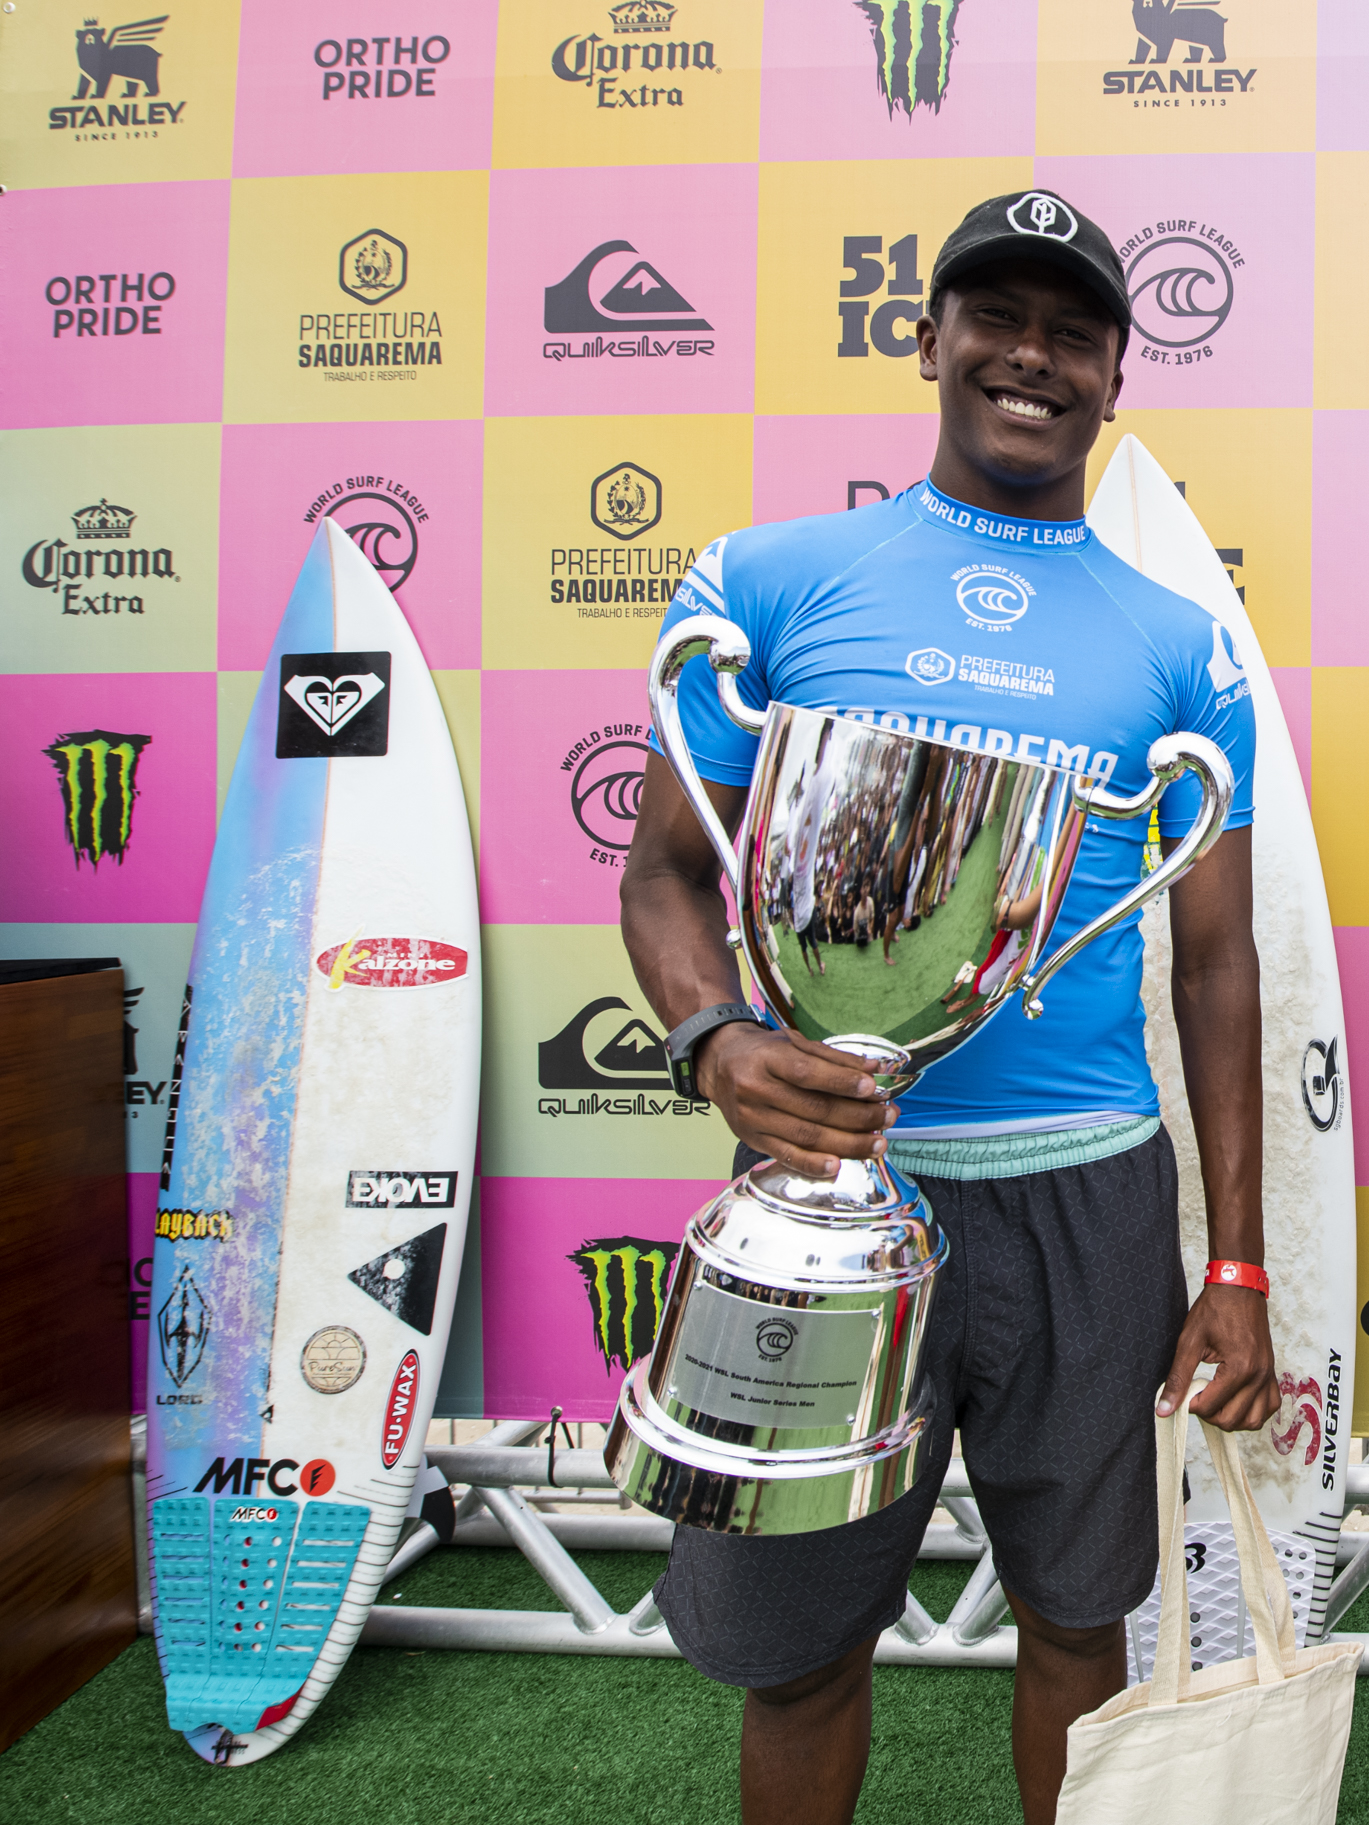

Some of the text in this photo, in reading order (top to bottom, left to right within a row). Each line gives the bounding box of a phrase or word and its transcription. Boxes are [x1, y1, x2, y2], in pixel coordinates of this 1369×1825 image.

[313, 35, 451, 69] ORTHO
[551, 33, 718, 87] Corona
[322, 67, 437, 101] PRIDE
[596, 76, 684, 109] Extra
[1102, 69, 1258, 95] STANLEY
[48, 101, 187, 130] STANLEY
[1133, 98, 1228, 108] SINCE 1913
[74, 129, 159, 142] SINCE 1913
[1119, 219, 1246, 271] ORLD SURF LEAGUE
[839, 234, 924, 298] 51
[45, 272, 176, 306] ORTHO
[52, 305, 164, 338] PRIDE
[299, 311, 443, 341] PREFEITURA
[837, 299, 923, 359] IC
[298, 340, 443, 368] SAQUAREMA
[542, 336, 716, 362] QUIKSILVER
[1140, 344, 1214, 366] EST. 1976
[323, 370, 418, 382] TRABALHO E RESPEITO
[303, 475, 430, 525] WORLD SURF LEAGUE
[919, 486, 972, 529] WORLD
[974, 517, 1029, 544] SURF
[1033, 525, 1087, 546] LEAGUE
[22, 538, 177, 594] Corona
[550, 548, 697, 575] PREFEITURA
[550, 578, 685, 605] SAQUAREM
[950, 563, 1037, 598] WORLD SURF LEAGUE
[61, 584, 145, 615] Extra
[577, 607, 667, 618] TRABALHO E RESPEIT
[965, 616, 1013, 634] EST. 1976
[958, 669, 1055, 697] SAQUAREMA
[960, 654, 1056, 683] PREFEITURA
[560, 730, 601, 772] WORLD
[604, 723, 643, 738] SURF
[589, 848, 618, 868] EST.
[328, 925, 456, 990] Kalzone
[714, 1367, 729, 1377] WSL
[731, 1372, 752, 1383] South
[753, 1377, 785, 1388] America
[786, 1381, 820, 1390] Regional
[821, 1380, 857, 1389] Champion
[730, 1392, 747, 1401] WSL
[748, 1395, 771, 1405] Junior
[773, 1399, 797, 1408] Series
